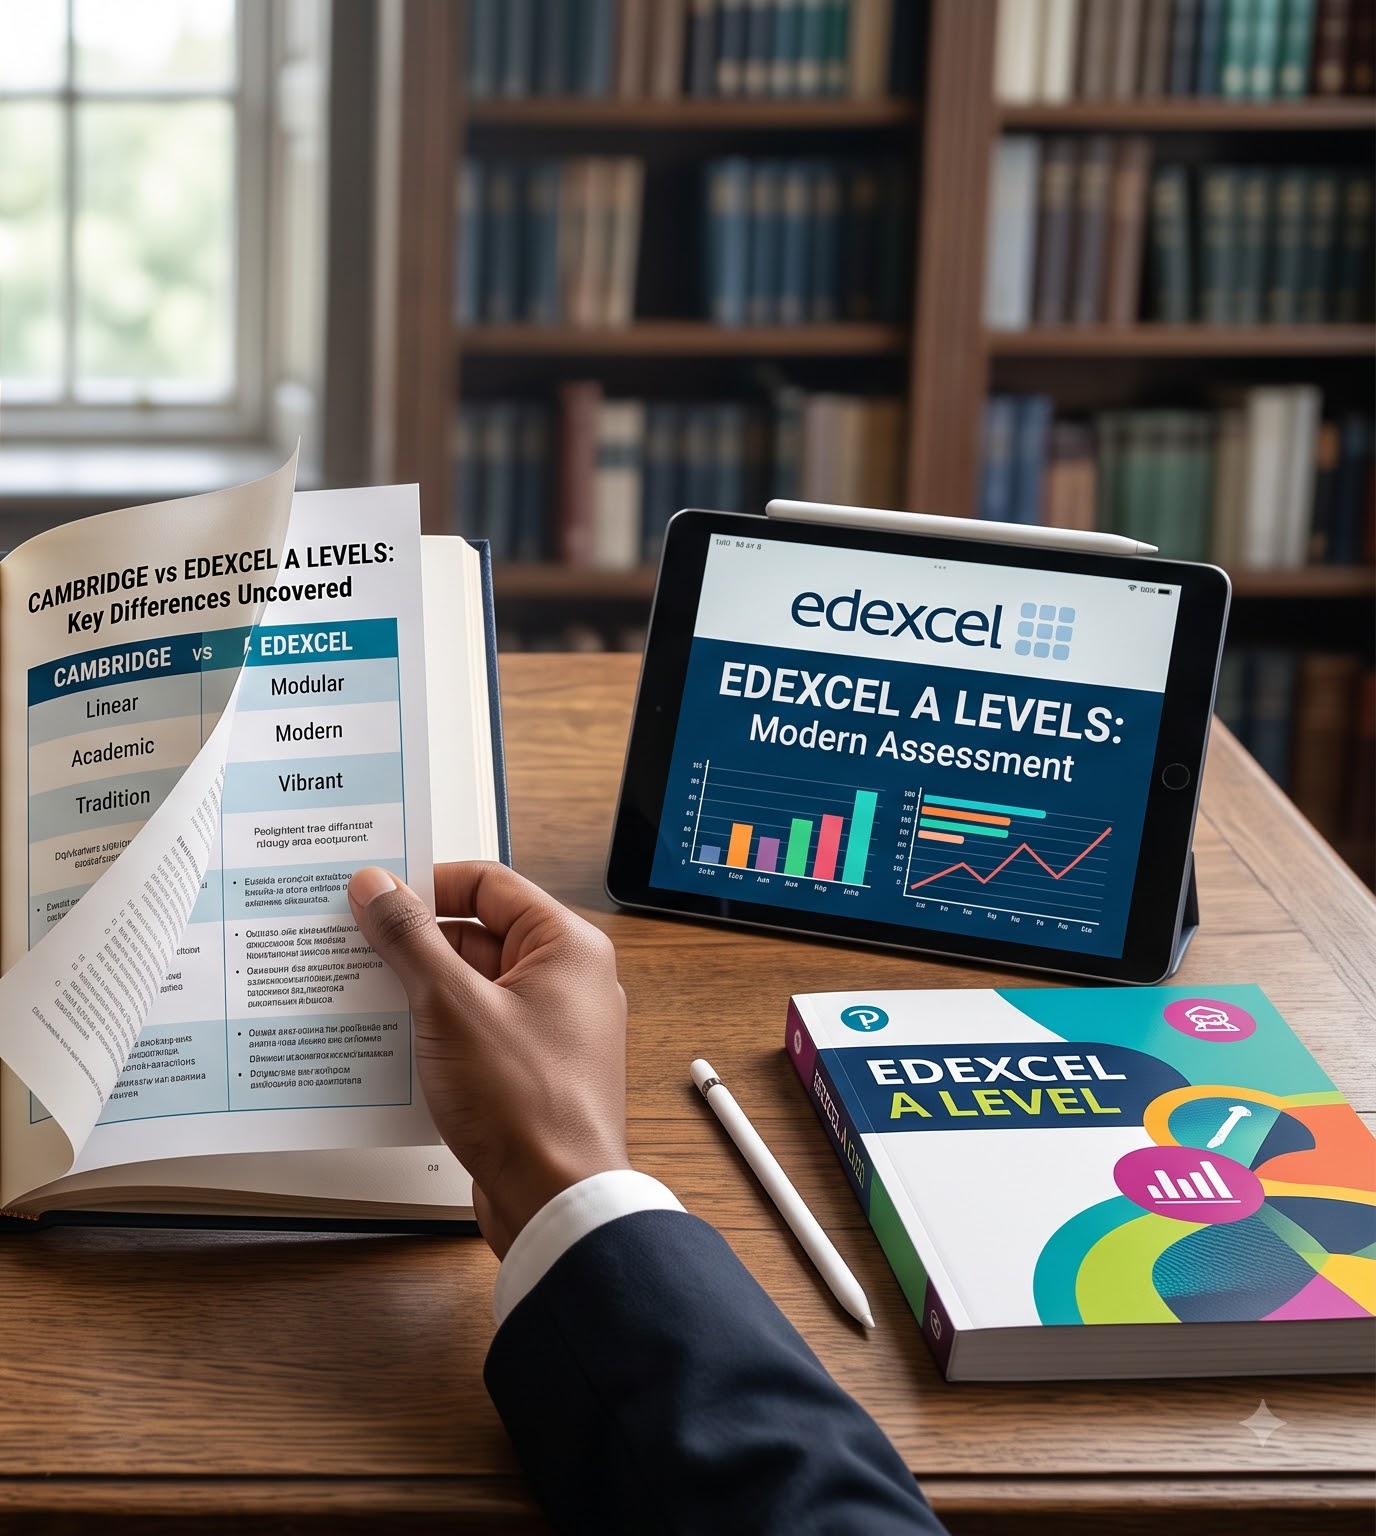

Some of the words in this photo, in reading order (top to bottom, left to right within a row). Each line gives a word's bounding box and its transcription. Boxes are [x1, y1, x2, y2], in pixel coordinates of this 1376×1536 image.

[27, 566, 148, 614] CAMBRIDGE
[155, 565, 177, 585] vs
[184, 548, 278, 581] EDEXCEL
[284, 548, 300, 570] A
[307, 542, 395, 568] LEVELS:
[68, 609, 104, 634] Key
[110, 588, 231, 625] Differences
[238, 576, 353, 605] Uncovered
[790, 589, 1003, 650] edexcel
[54, 646, 172, 688] CAMBRIDGE
[260, 631, 353, 656] EDEXCEL
[271, 675, 345, 696] Modular
[86, 696, 138, 719] Linear
[719, 661, 900, 718] EDEXCEL
[910, 686, 941, 722] A
[954, 691, 1125, 745] LEVELS:
[276, 722, 343, 742] Modern
[749, 713, 867, 756] Modern
[876, 730, 1074, 783] Assessment
[71, 738, 155, 768] Academic
[278, 772, 344, 793] Vibrant
[76, 787, 151, 815] Tradition
[866, 1055, 1127, 1087] EDEXCEL
[889, 1091, 933, 1120] A
[939, 1087, 1123, 1118] LEVEL
